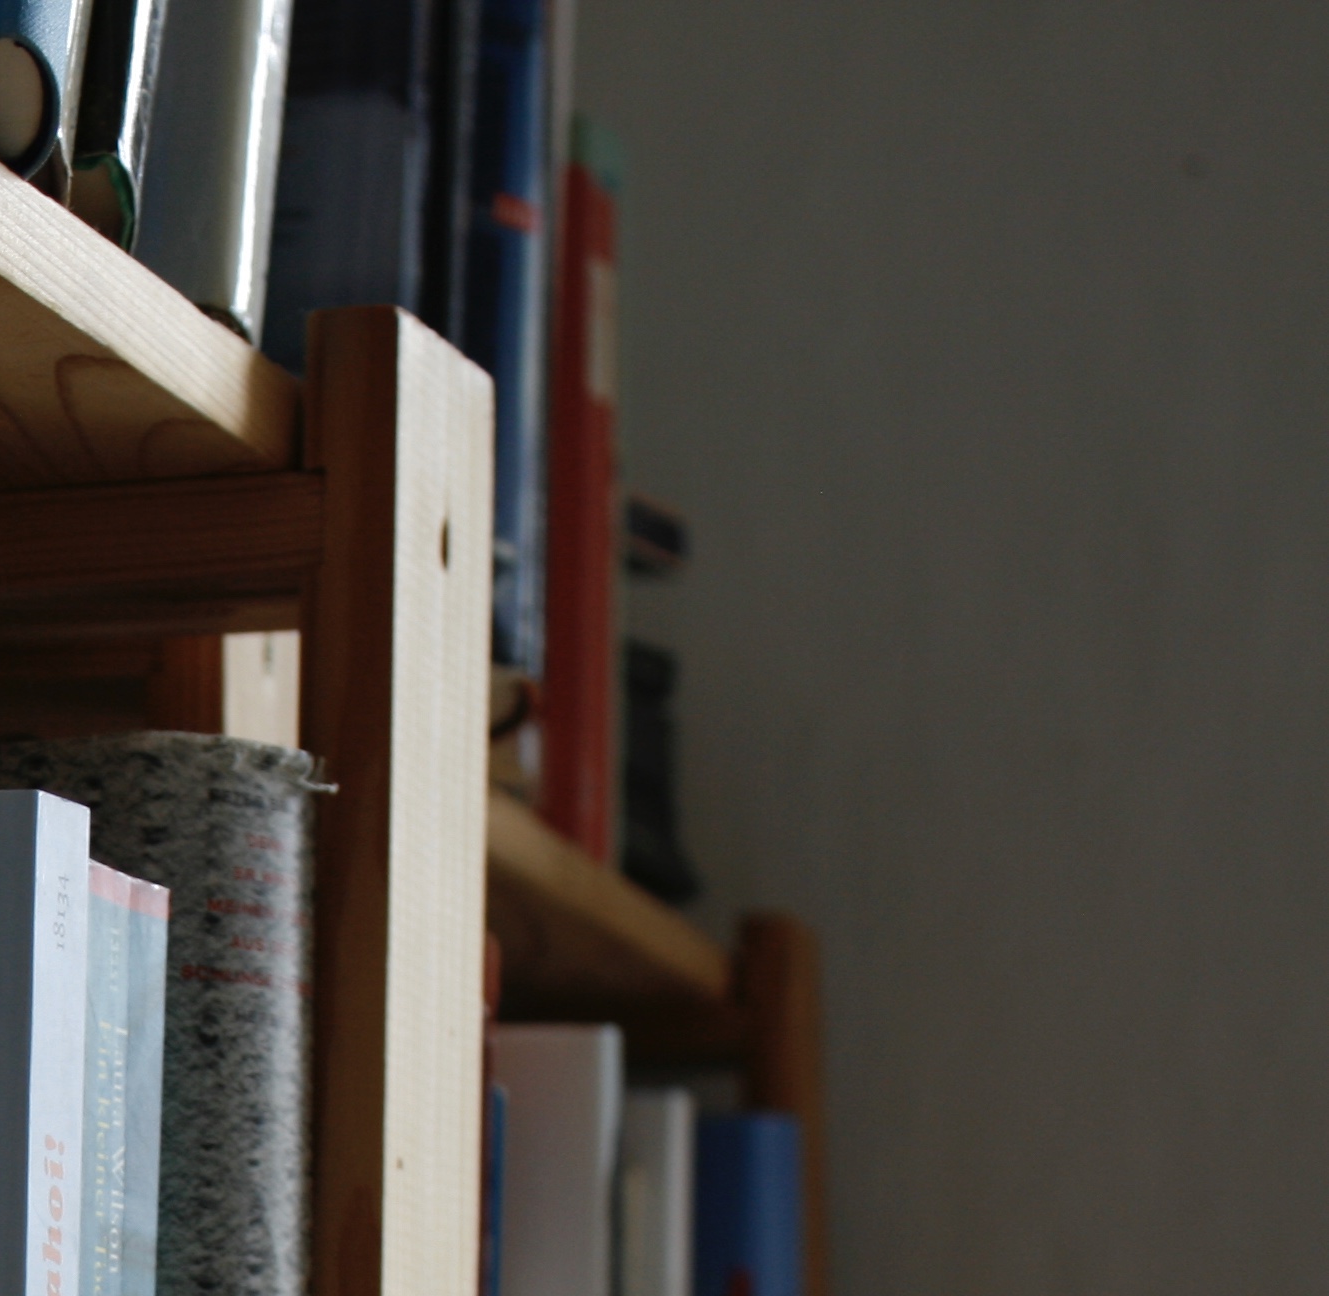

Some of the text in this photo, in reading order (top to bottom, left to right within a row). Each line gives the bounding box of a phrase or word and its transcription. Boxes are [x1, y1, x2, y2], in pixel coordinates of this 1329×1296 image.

[52, 873, 70, 953] 18134
[98, 1020, 112, 1081] Ein
[95, 1097, 112, 1218] kleiner
[108, 1026, 129, 1275] Laura Wilson
